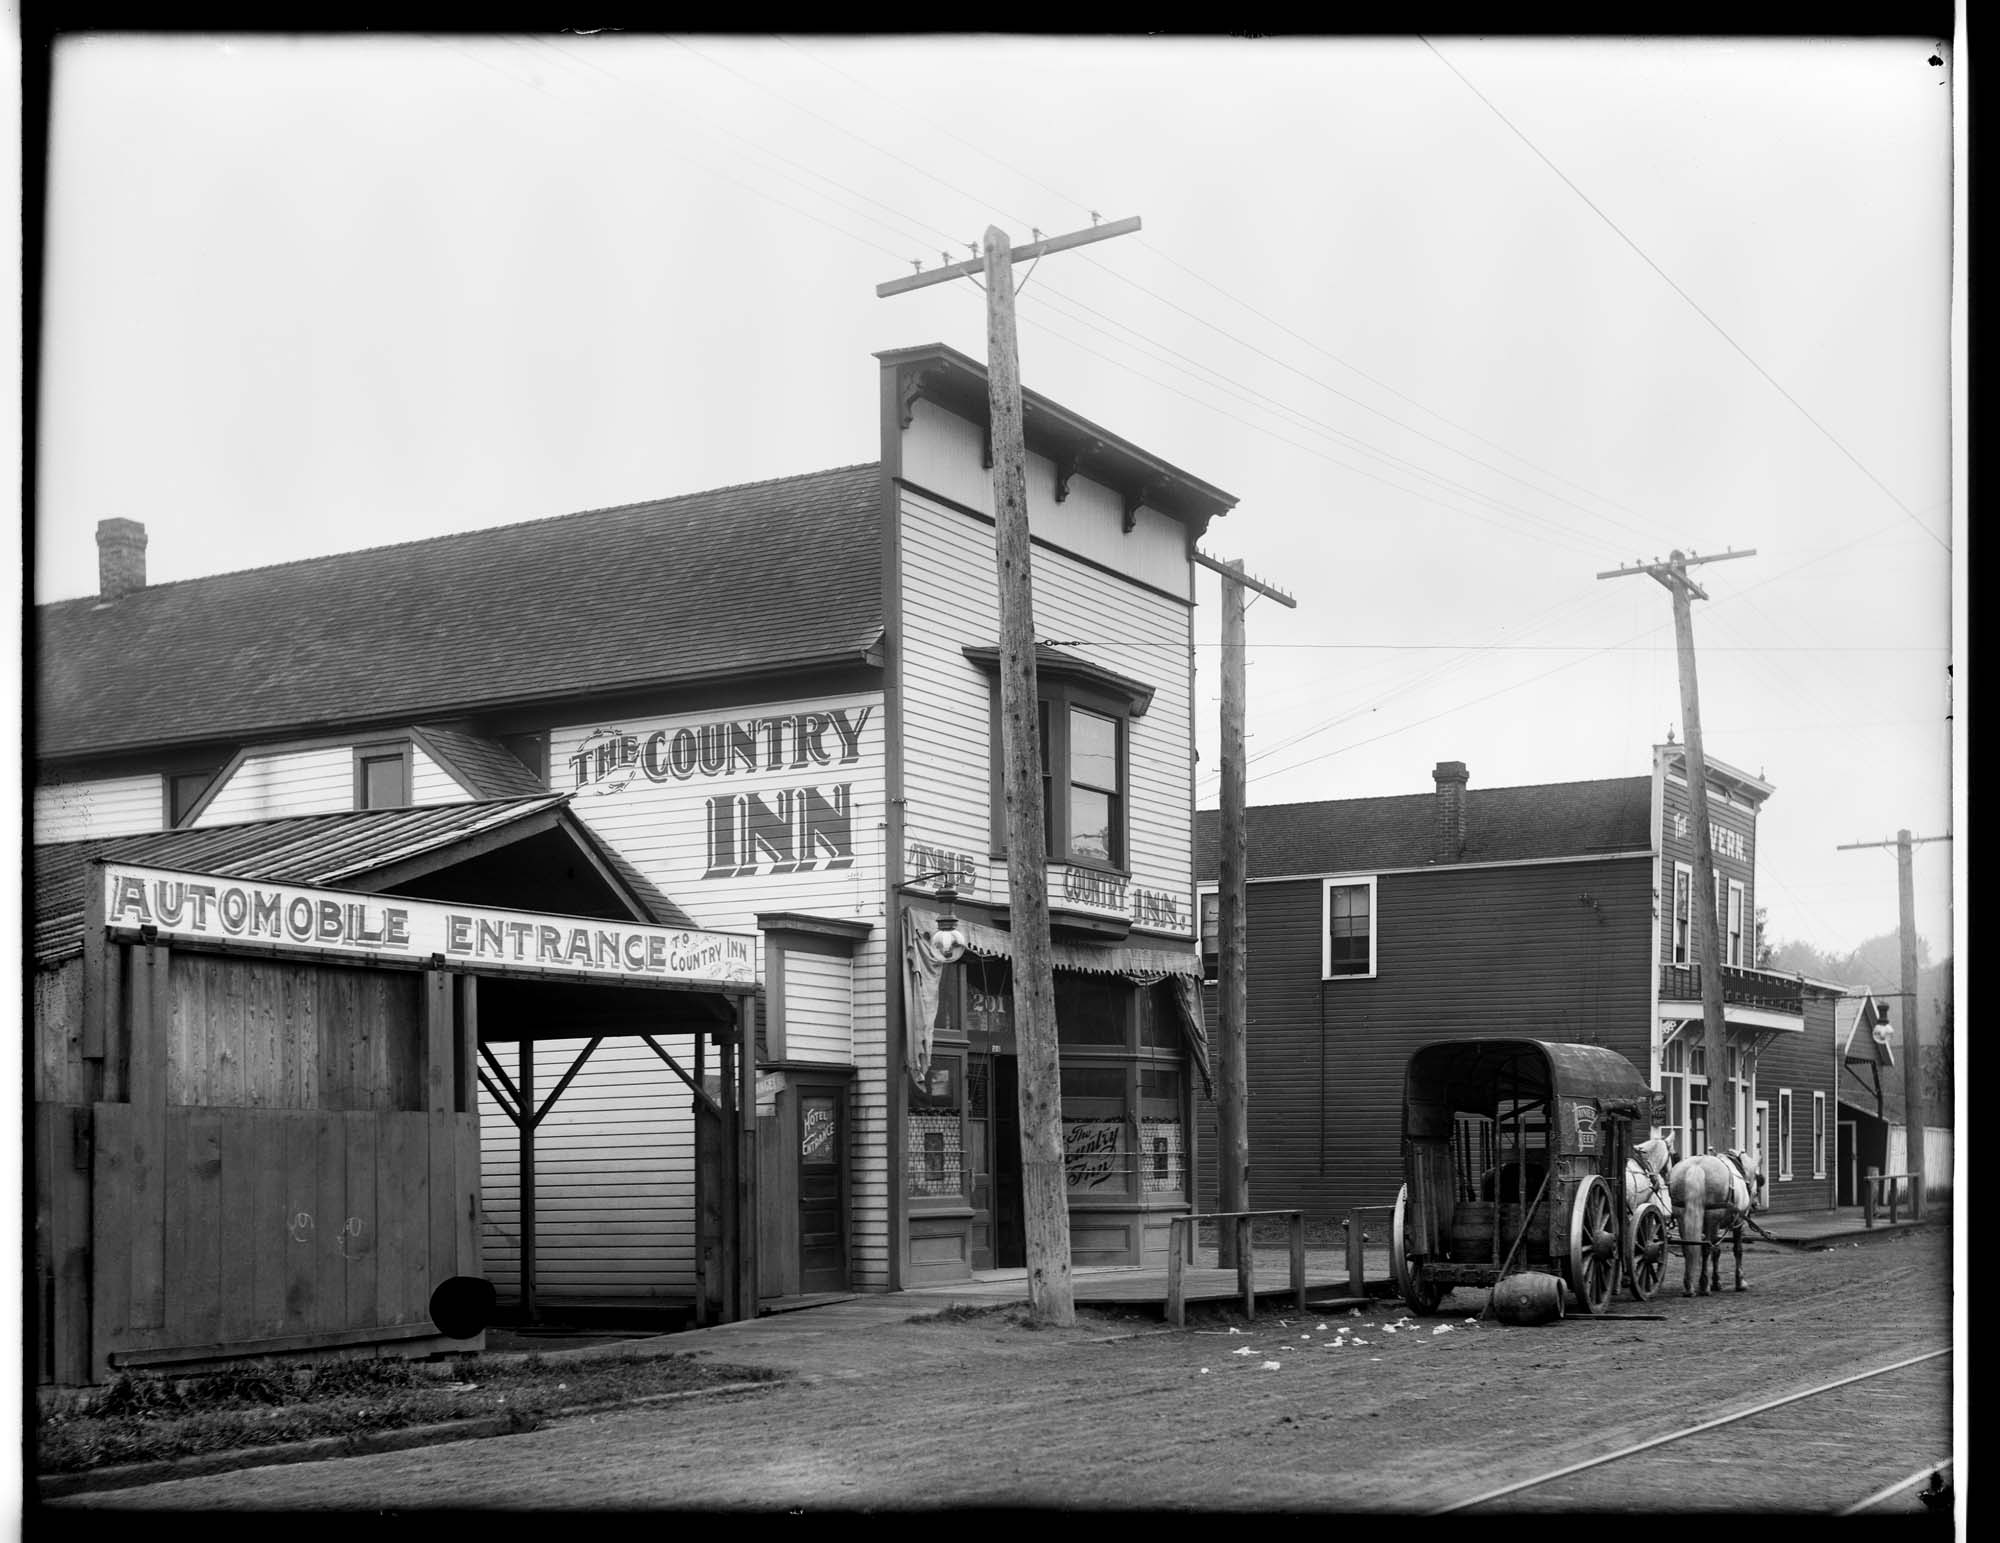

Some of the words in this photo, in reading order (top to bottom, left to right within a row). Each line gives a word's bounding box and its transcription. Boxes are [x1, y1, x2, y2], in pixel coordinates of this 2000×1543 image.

[569, 735, 640, 790] THE
[640, 706, 873, 783] COUNTRY
[700, 783, 855, 880] INN
[908, 843, 976, 896] THE
[1064, 866, 1129, 912] COUNTRY
[109, 875, 410, 950] AUTOMOBILE
[446, 914, 667, 973] ENTRANCE
[670, 943, 722, 972] COUNTRY
[726, 936, 748, 963] INN
[803, 1108, 829, 1138] HOTEL
[1063, 1127, 1120, 1164] ountry
